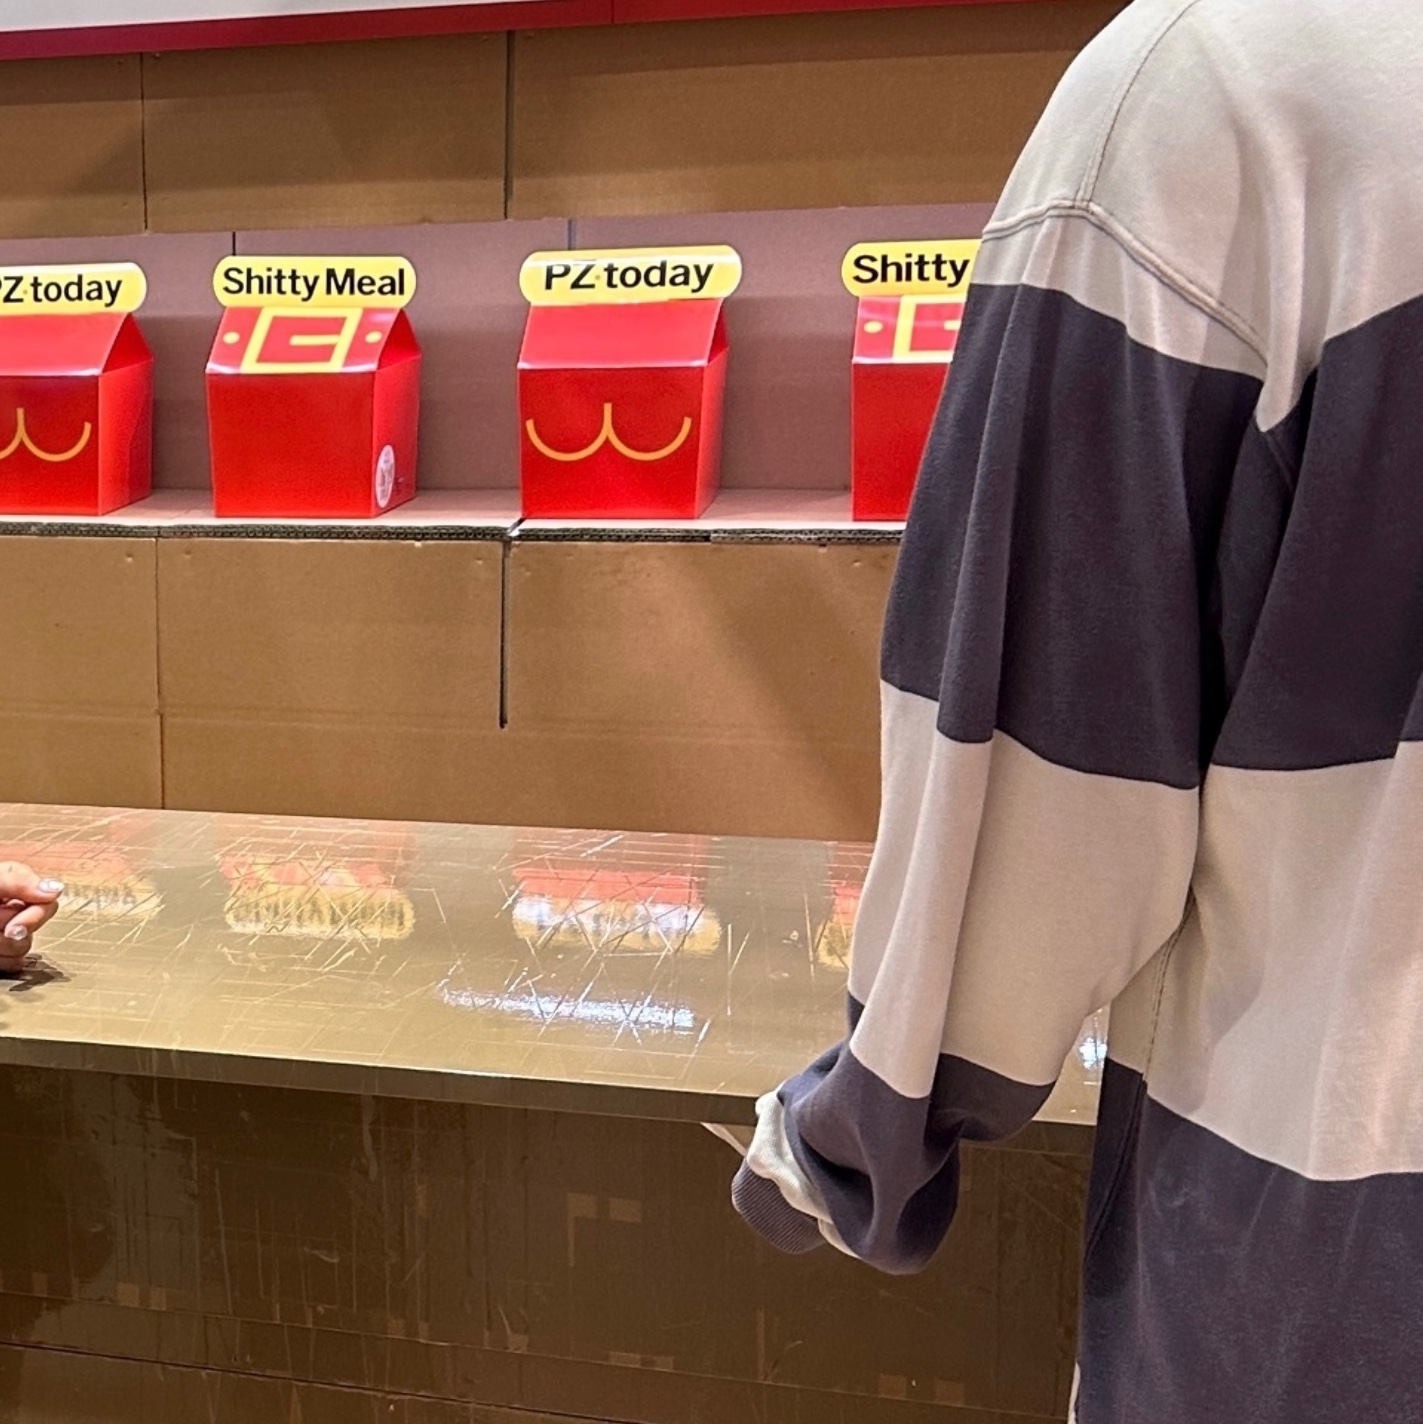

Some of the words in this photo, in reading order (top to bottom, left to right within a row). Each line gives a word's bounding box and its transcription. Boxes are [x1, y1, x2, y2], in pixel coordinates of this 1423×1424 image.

[222, 266, 320, 302] Shitty
[325, 267, 405, 296] Meal
[544, 259, 597, 290] PZ
[603, 259, 714, 293] today
[852, 252, 971, 288] Shitty
[30, 273, 123, 308] today
